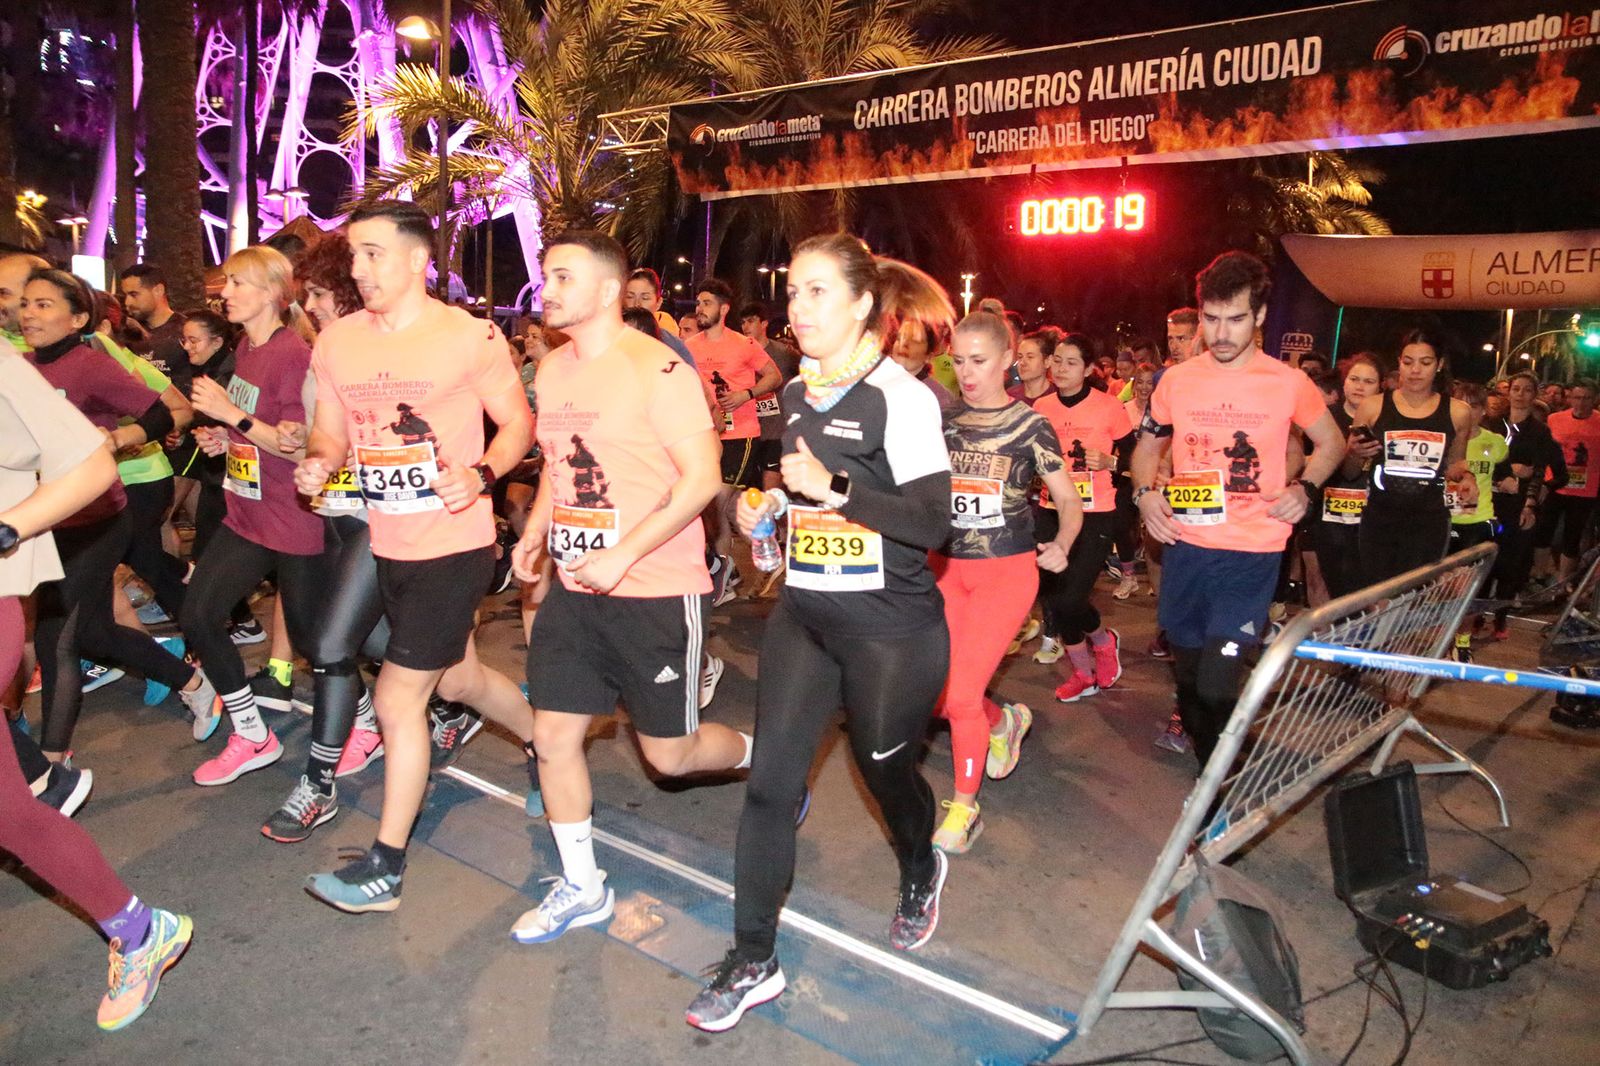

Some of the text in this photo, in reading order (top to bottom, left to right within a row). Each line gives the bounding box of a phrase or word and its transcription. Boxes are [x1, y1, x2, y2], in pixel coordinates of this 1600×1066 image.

[853, 36, 1322, 130] CARRERA BOMBEROS ALMERÍA CIUDAD
[716, 114, 821, 142] cruzandolameta
[1055, 121, 1086, 148] DEL
[1486, 280, 1565, 296] CIUDAD
[1407, 441, 1429, 456] 70
[325, 470, 353, 485] 82
[372, 467, 426, 491] 346
[954, 495, 980, 515] 61
[1173, 488, 1213, 502] 2022
[1333, 499, 1363, 510] 2494
[561, 528, 606, 553] 344
[803, 535, 864, 556] 2339
